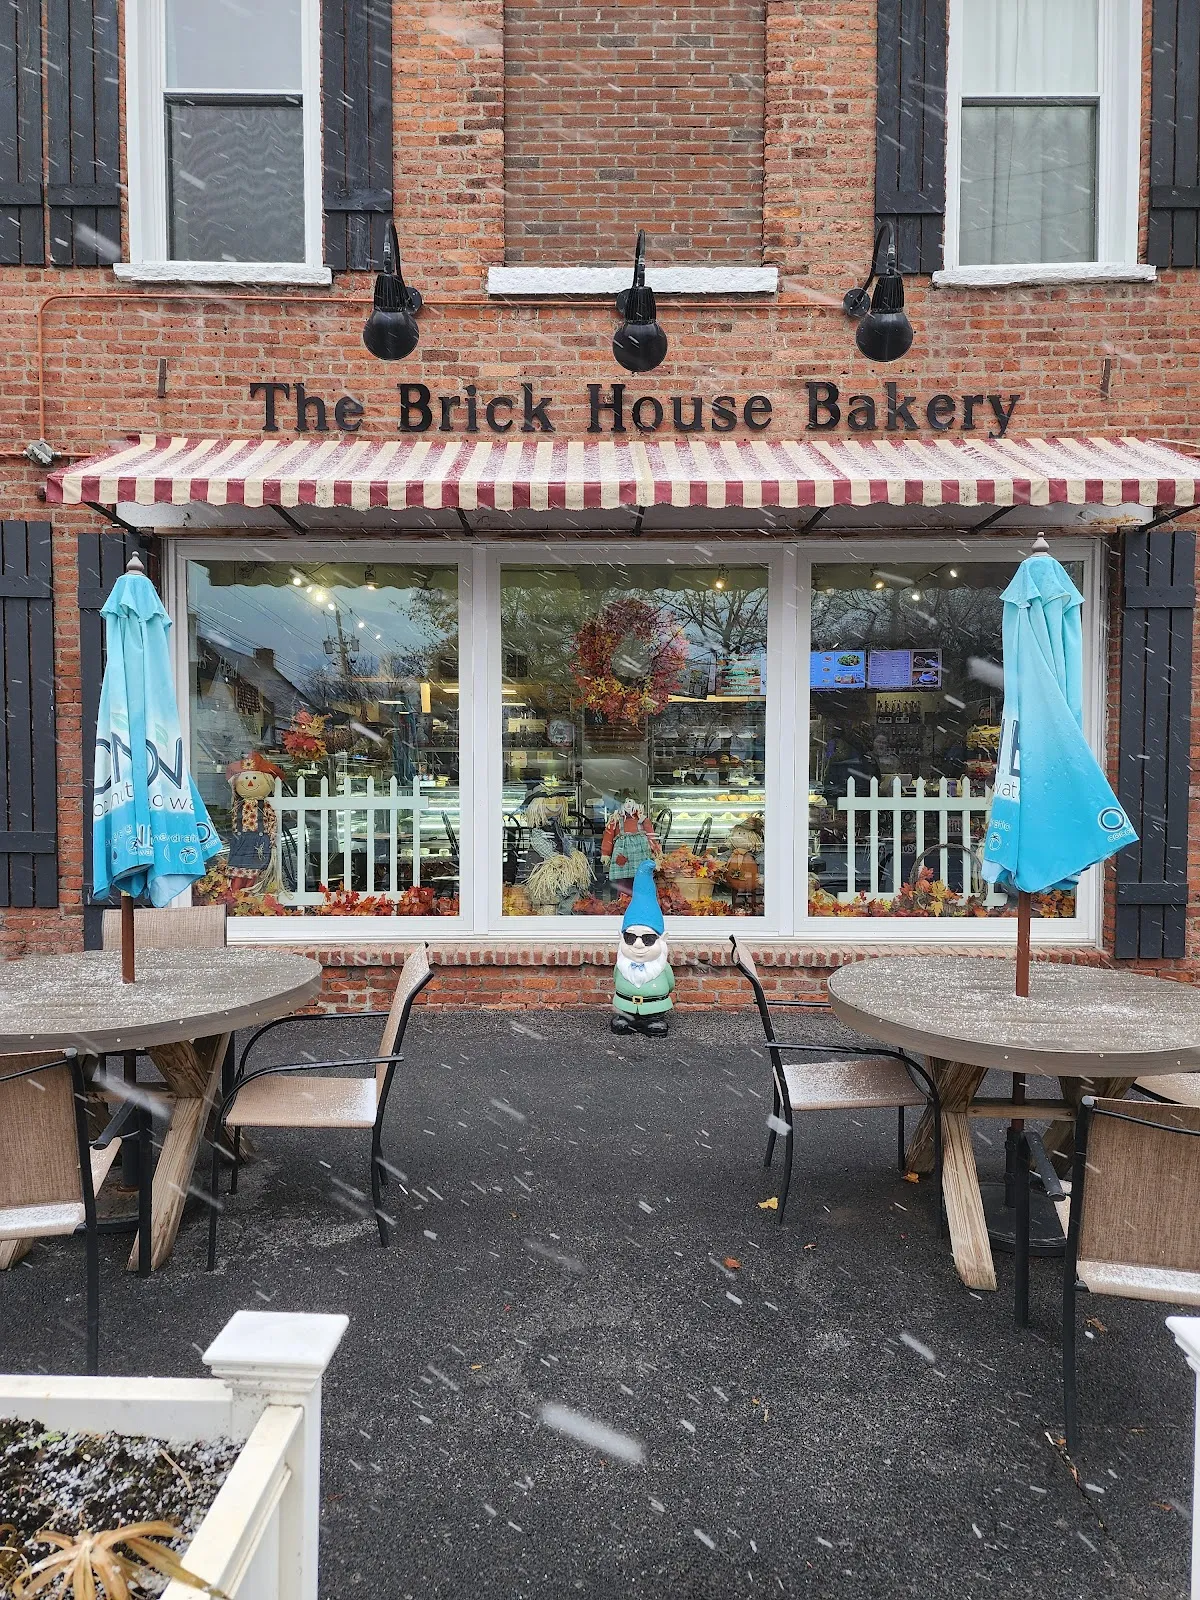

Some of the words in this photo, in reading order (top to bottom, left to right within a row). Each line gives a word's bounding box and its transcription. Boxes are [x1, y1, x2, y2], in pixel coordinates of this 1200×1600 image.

[249, 382, 363, 433] The
[398, 383, 555, 433] Brick
[586, 383, 773, 433] House
[805, 381, 1021, 439] Bakery
